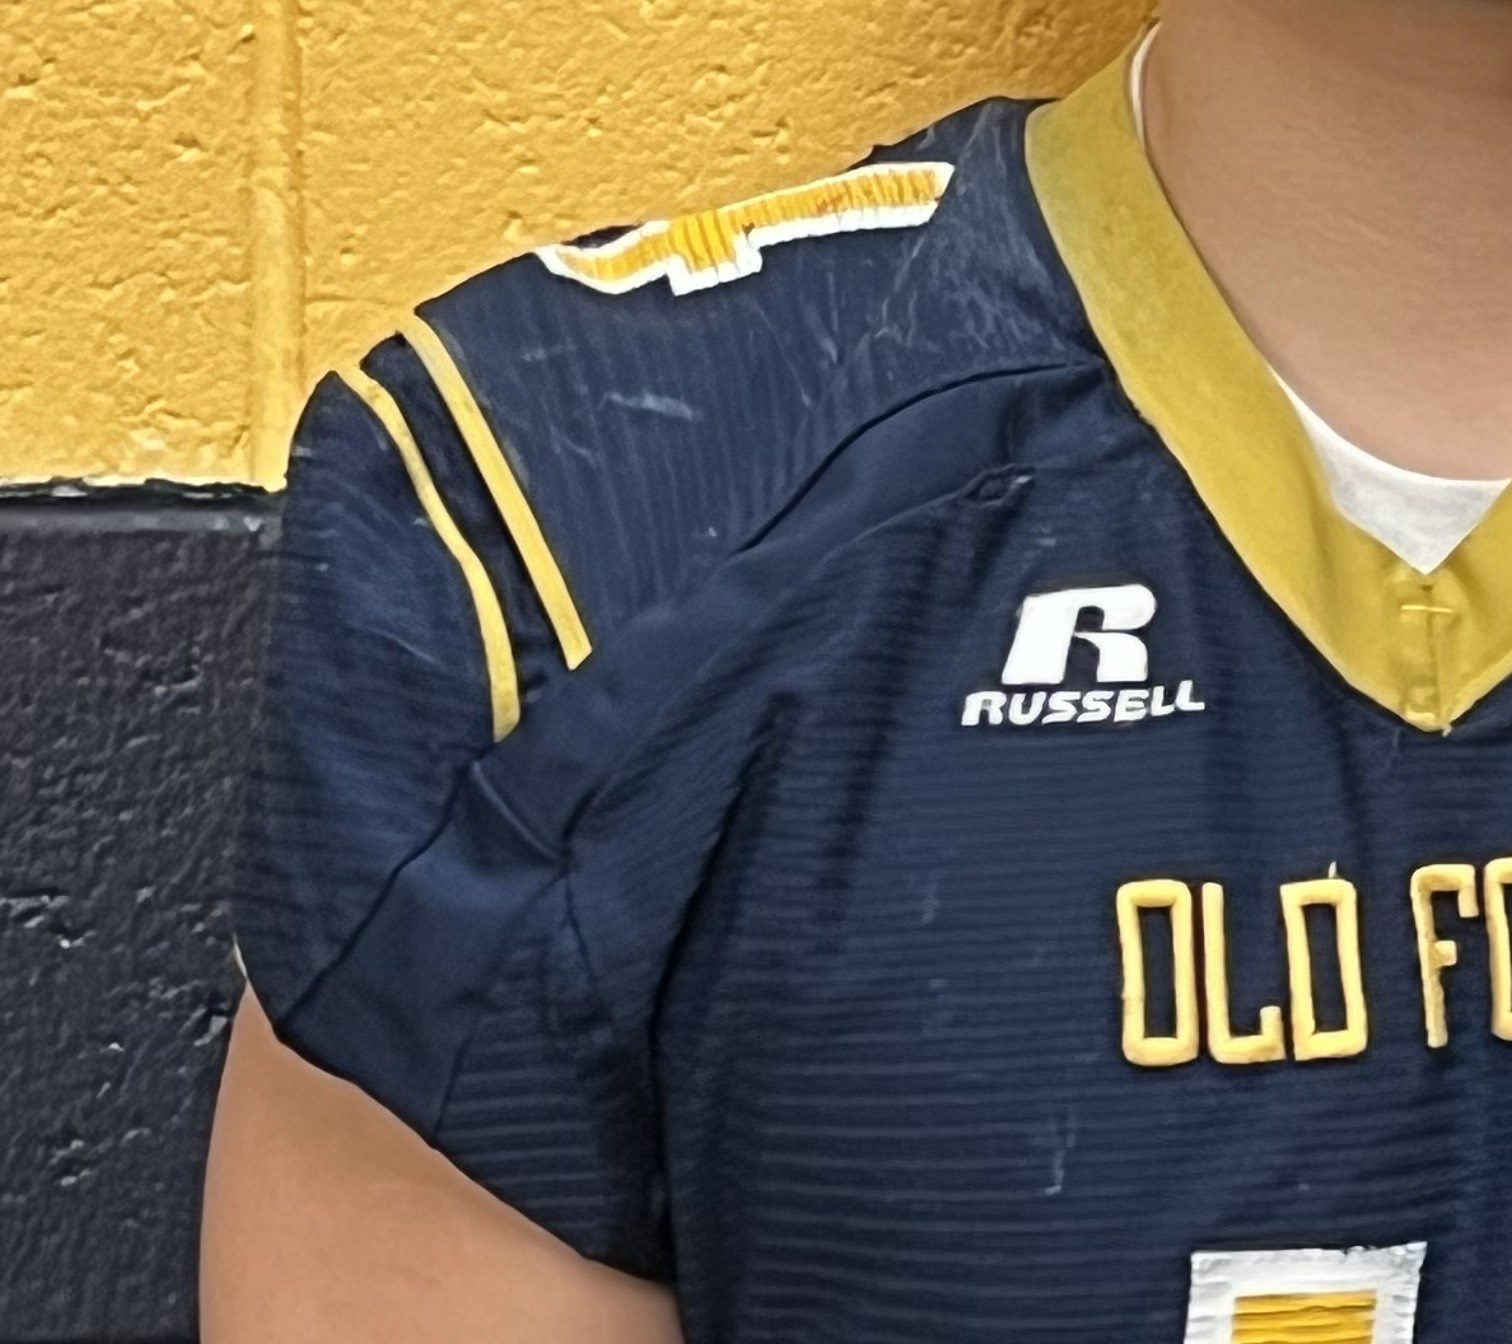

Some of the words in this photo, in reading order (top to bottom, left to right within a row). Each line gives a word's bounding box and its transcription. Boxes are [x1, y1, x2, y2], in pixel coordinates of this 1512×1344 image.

[1001, 583, 1158, 685] R
[961, 679, 1205, 726] RUSSELL
[1116, 877, 1369, 1067] OLD
